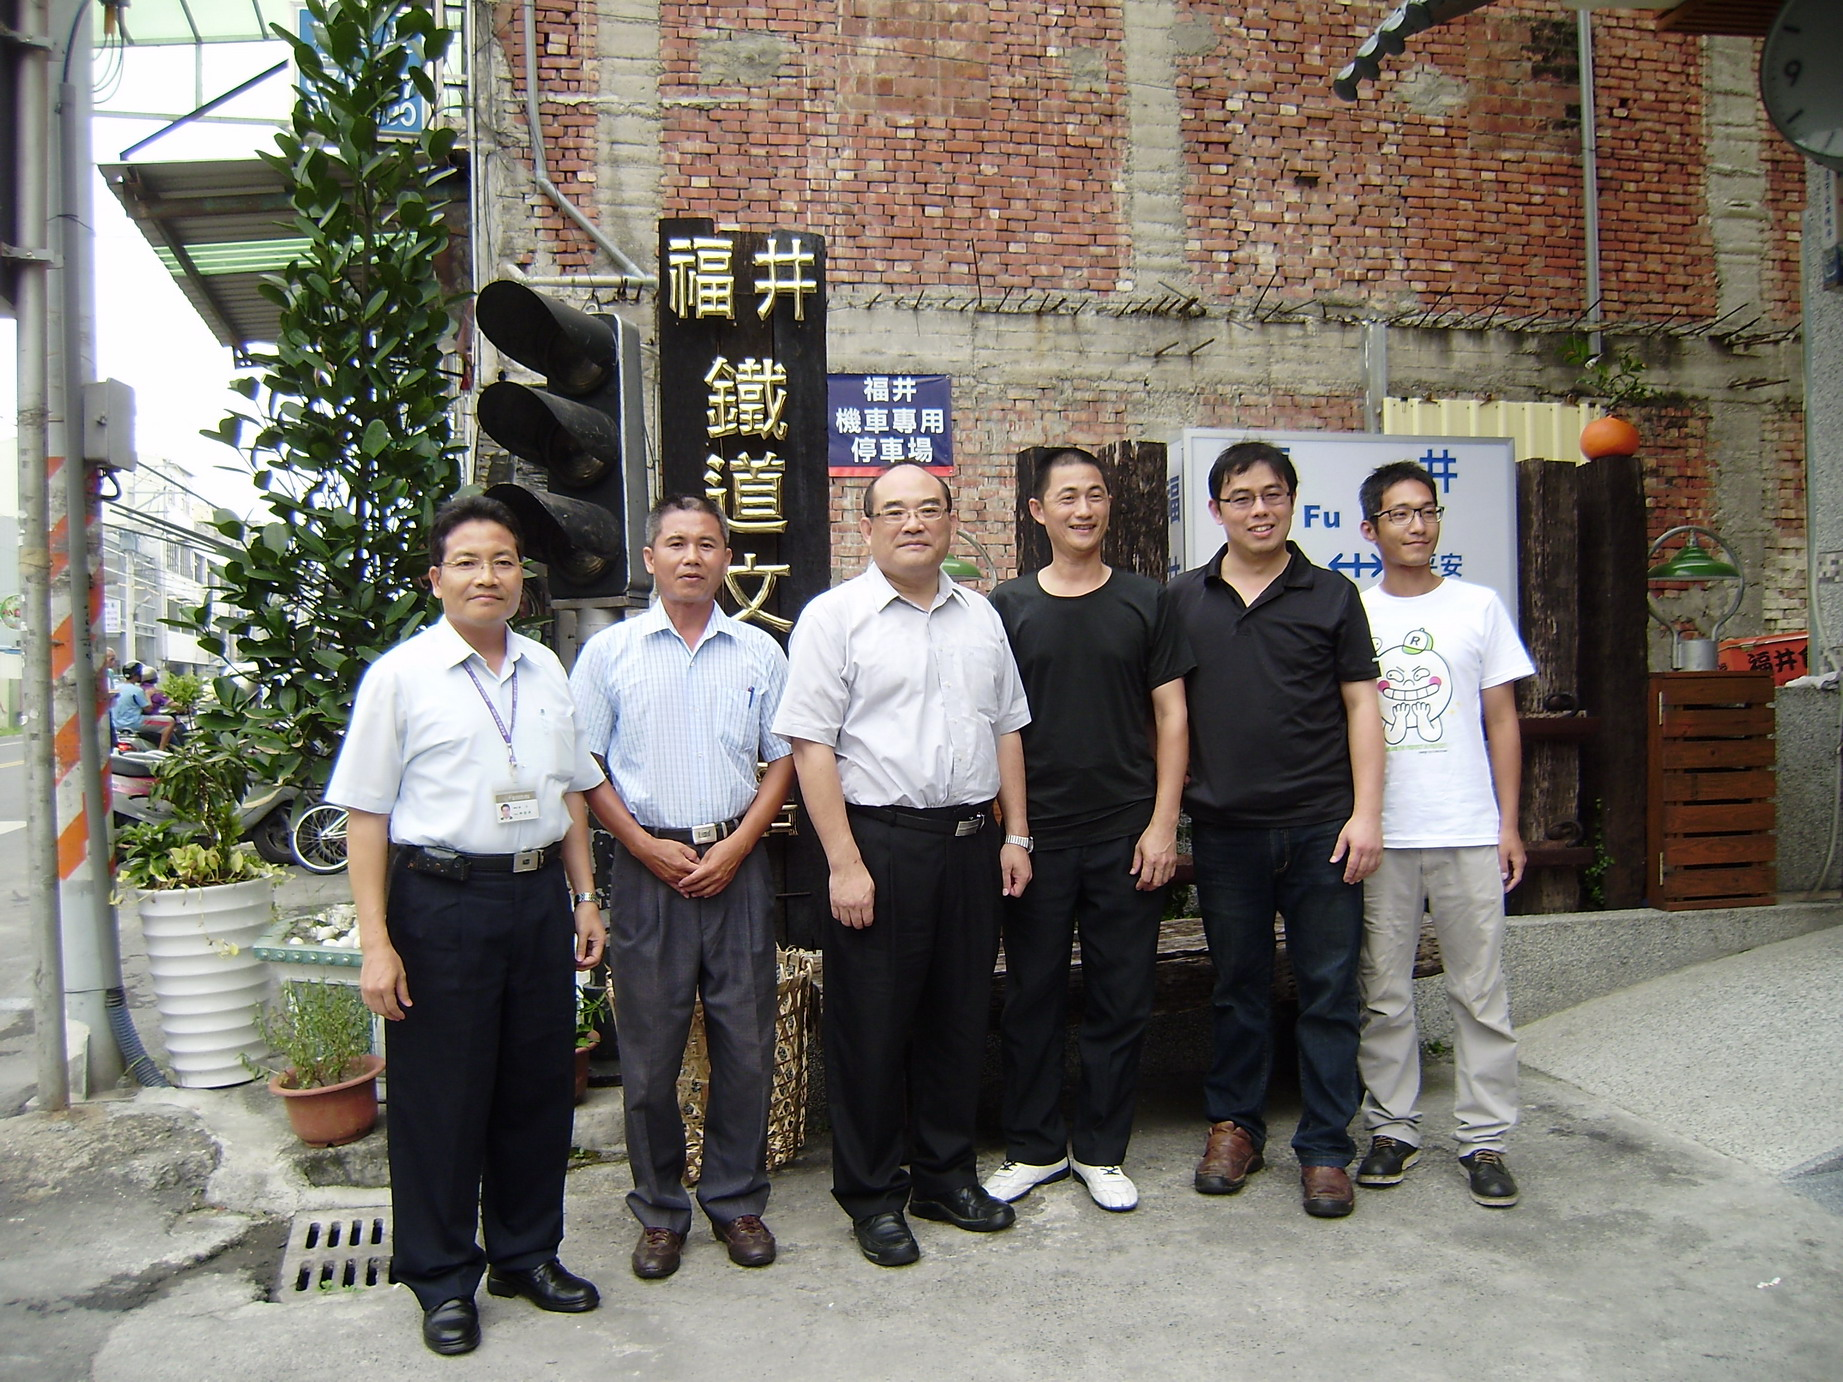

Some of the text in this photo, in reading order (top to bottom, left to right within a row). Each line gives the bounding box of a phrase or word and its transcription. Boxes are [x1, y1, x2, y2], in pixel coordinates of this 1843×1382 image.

[1784, 60, 1801, 87] 9
[668, 237, 818, 321] 福井
[863, 376, 917, 403] 福井
[835, 407, 944, 434] 機車專用
[851, 436, 933, 463] 停車場
[1303, 504, 1341, 529] Fu
[1410, 636, 1421, 646] R
[1747, 645, 1808, 673] 福井
